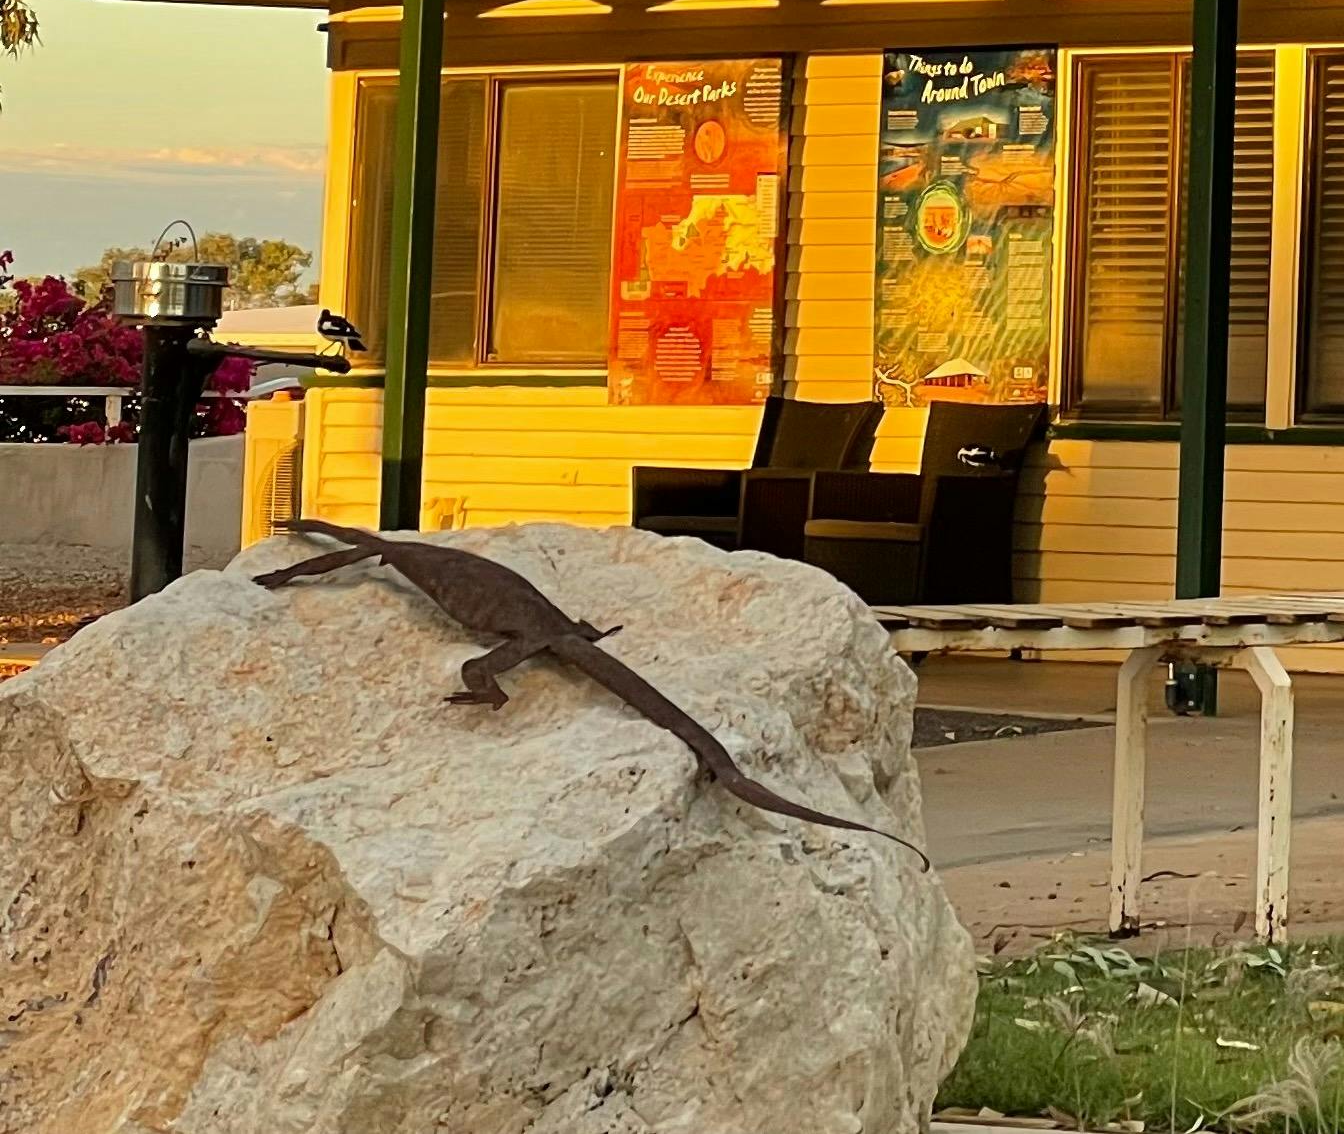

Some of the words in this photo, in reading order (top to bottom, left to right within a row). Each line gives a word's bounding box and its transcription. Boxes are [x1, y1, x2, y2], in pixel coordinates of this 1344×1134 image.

[645, 65, 704, 85] Experience
[909, 55, 943, 77] Things
[944, 61, 957, 76] to
[959, 56, 973, 74] do
[633, 86, 657, 105] Our
[658, 87, 701, 106] Desert
[702, 80, 737, 102] Parks
[921, 76, 968, 104] Around
[970, 71, 1005, 96] Town
